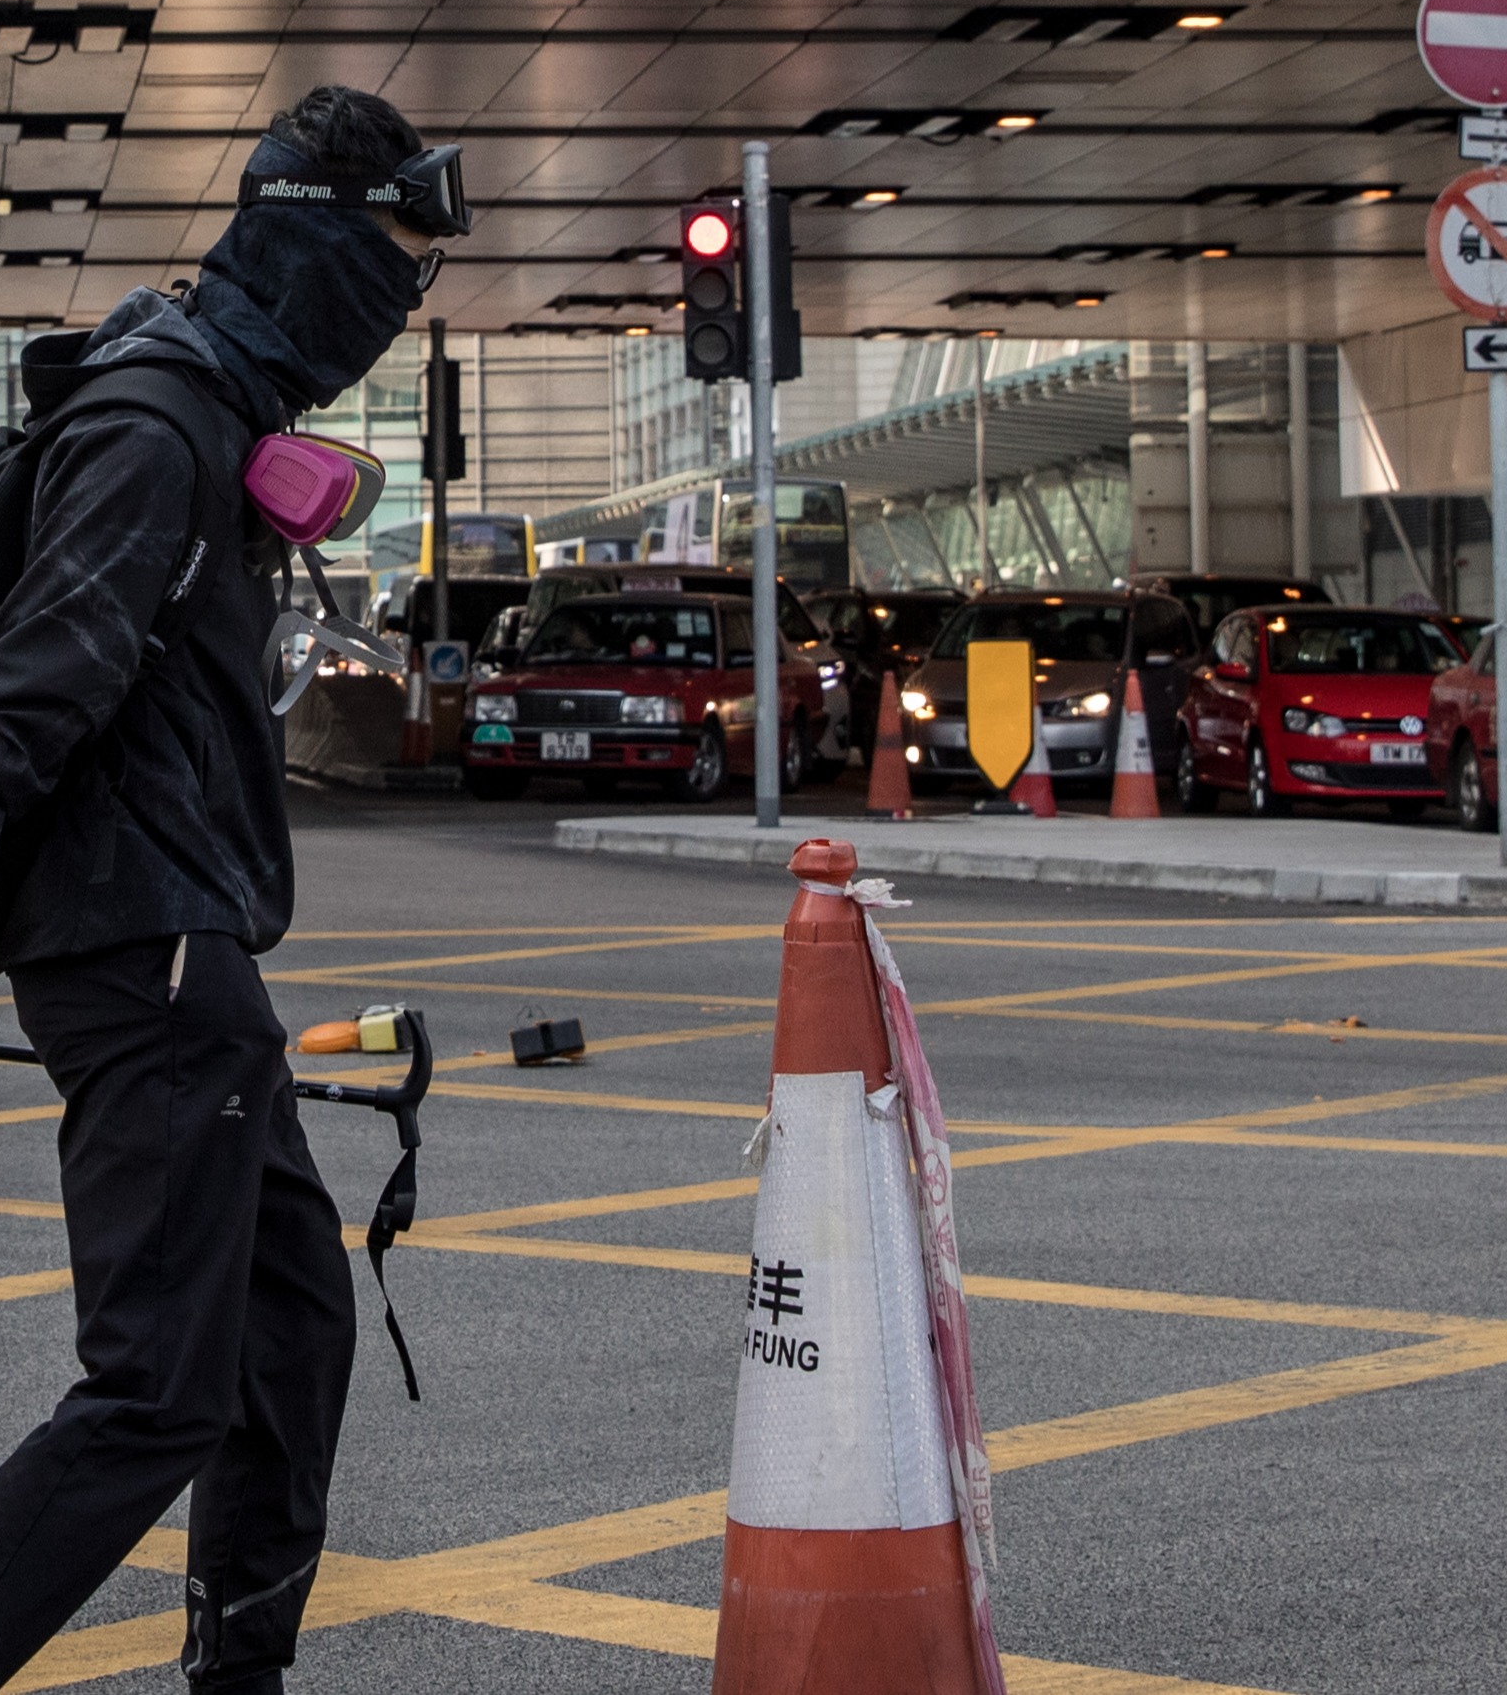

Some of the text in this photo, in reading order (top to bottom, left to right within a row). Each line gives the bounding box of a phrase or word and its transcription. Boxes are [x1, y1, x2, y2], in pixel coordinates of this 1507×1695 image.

[366, 183, 401, 202] sells
[747, 1252, 805, 1326] 丰
[751, 1329, 821, 1372] FUNG
